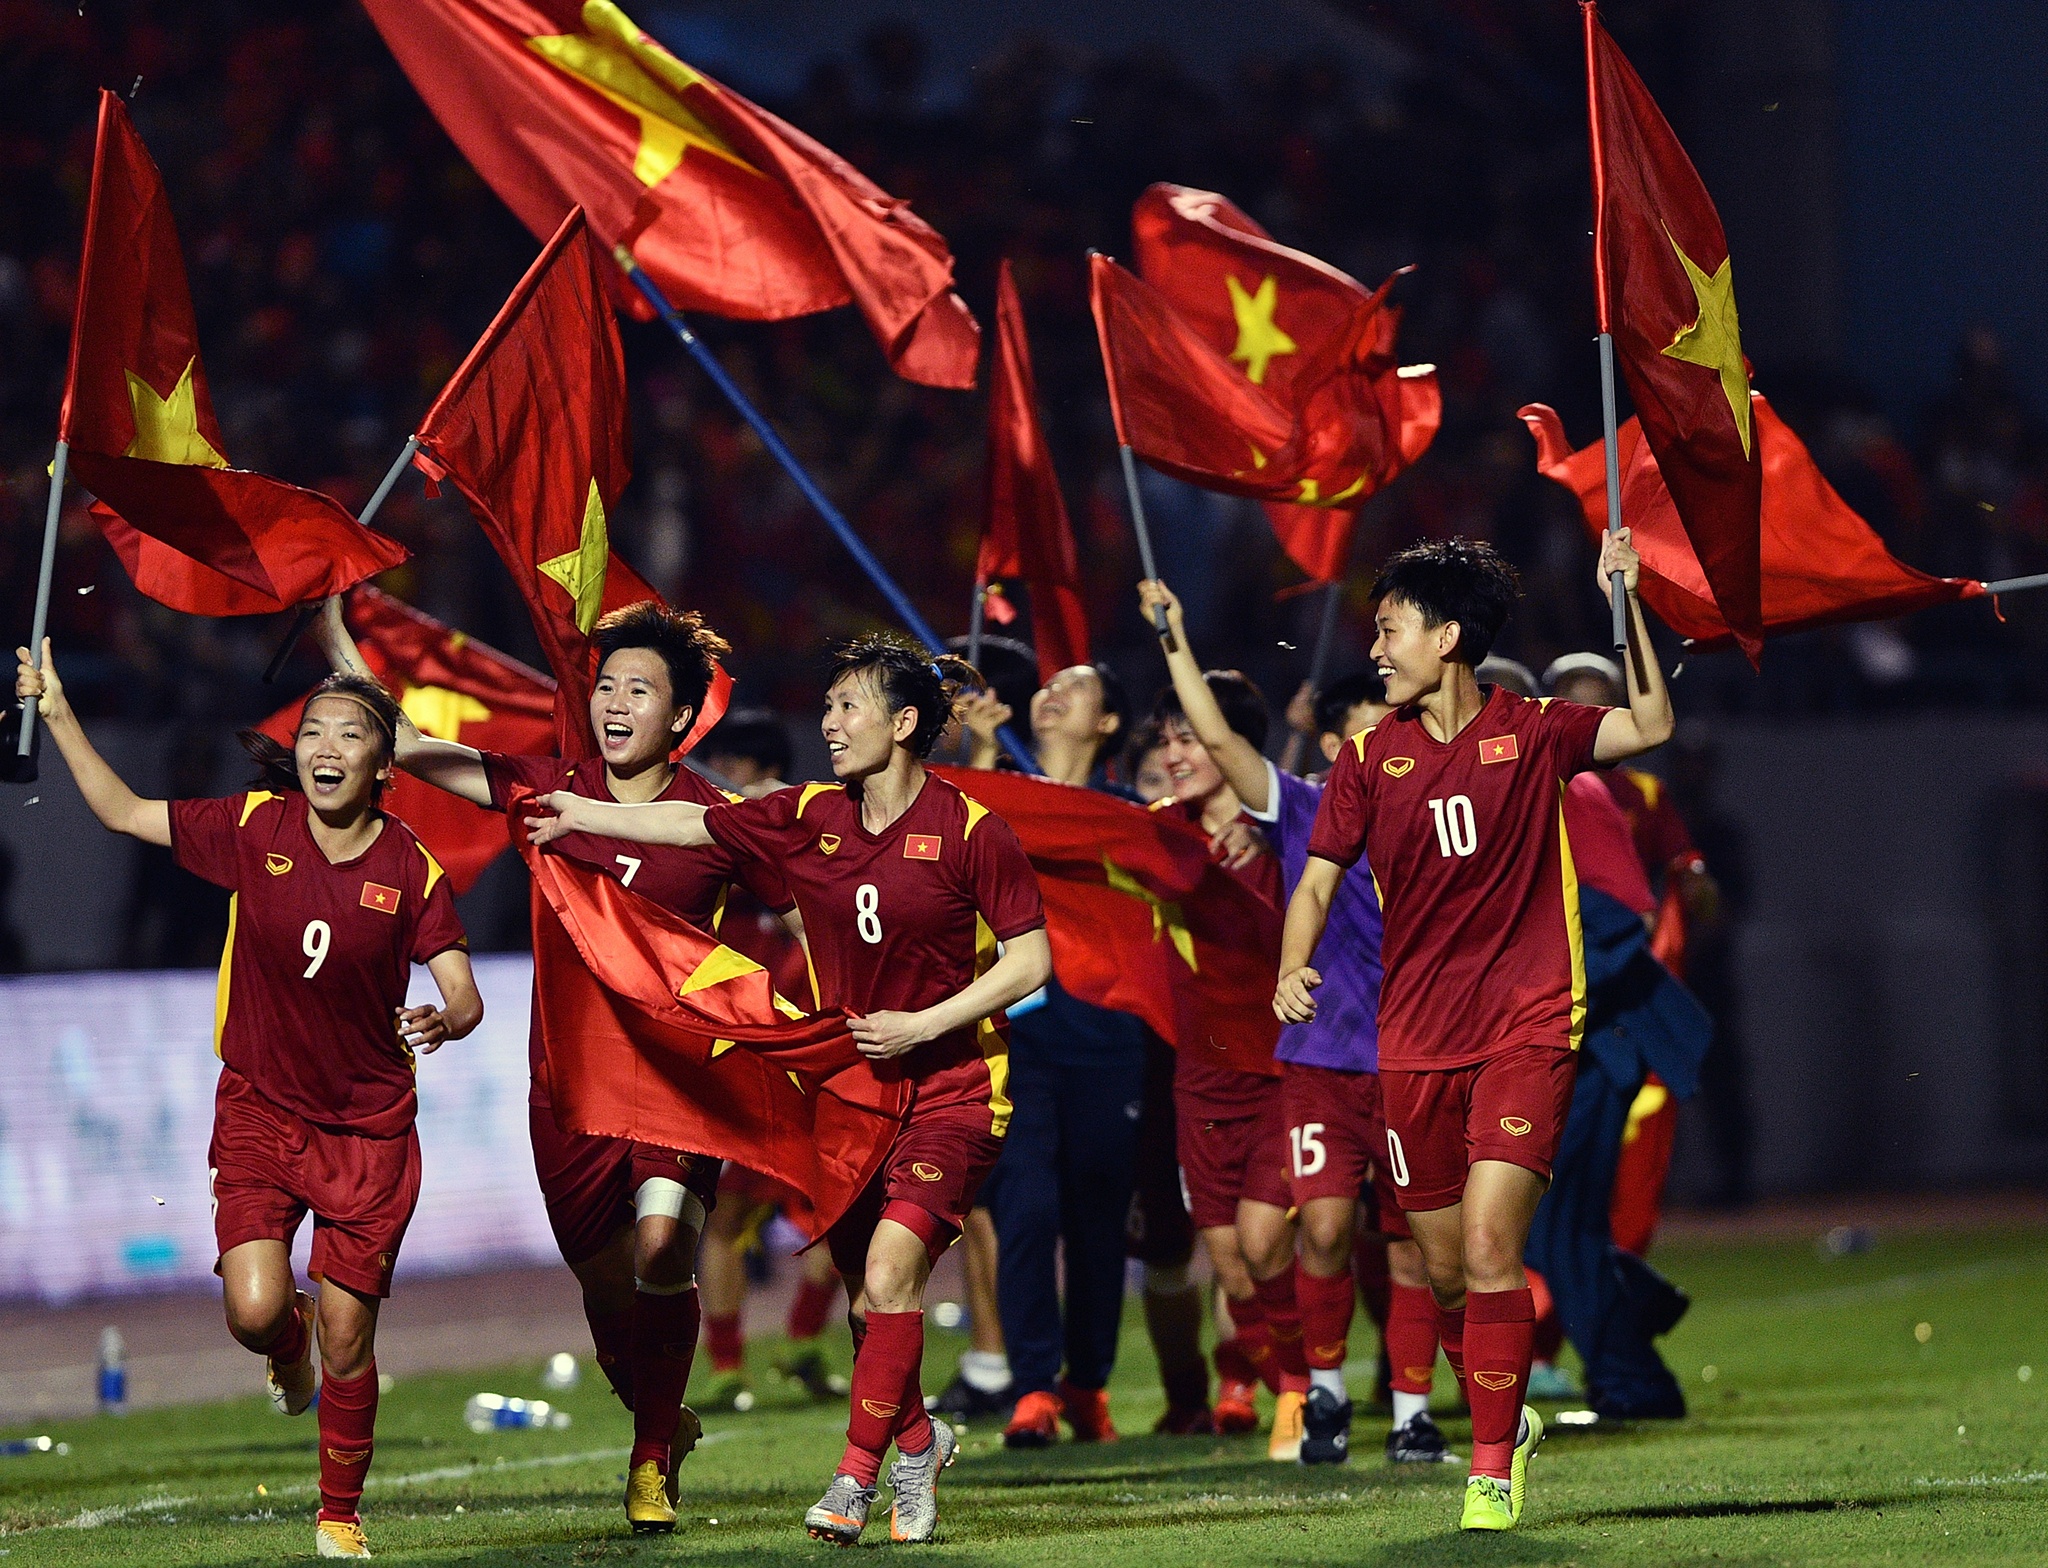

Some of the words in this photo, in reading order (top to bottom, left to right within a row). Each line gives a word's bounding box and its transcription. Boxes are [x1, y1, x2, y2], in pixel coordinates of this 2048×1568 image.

[1428, 794, 1477, 858] 10
[615, 854, 642, 888] 7
[855, 883, 883, 944] 8
[302, 919, 331, 979] 9
[1289, 1122, 1327, 1178] 15
